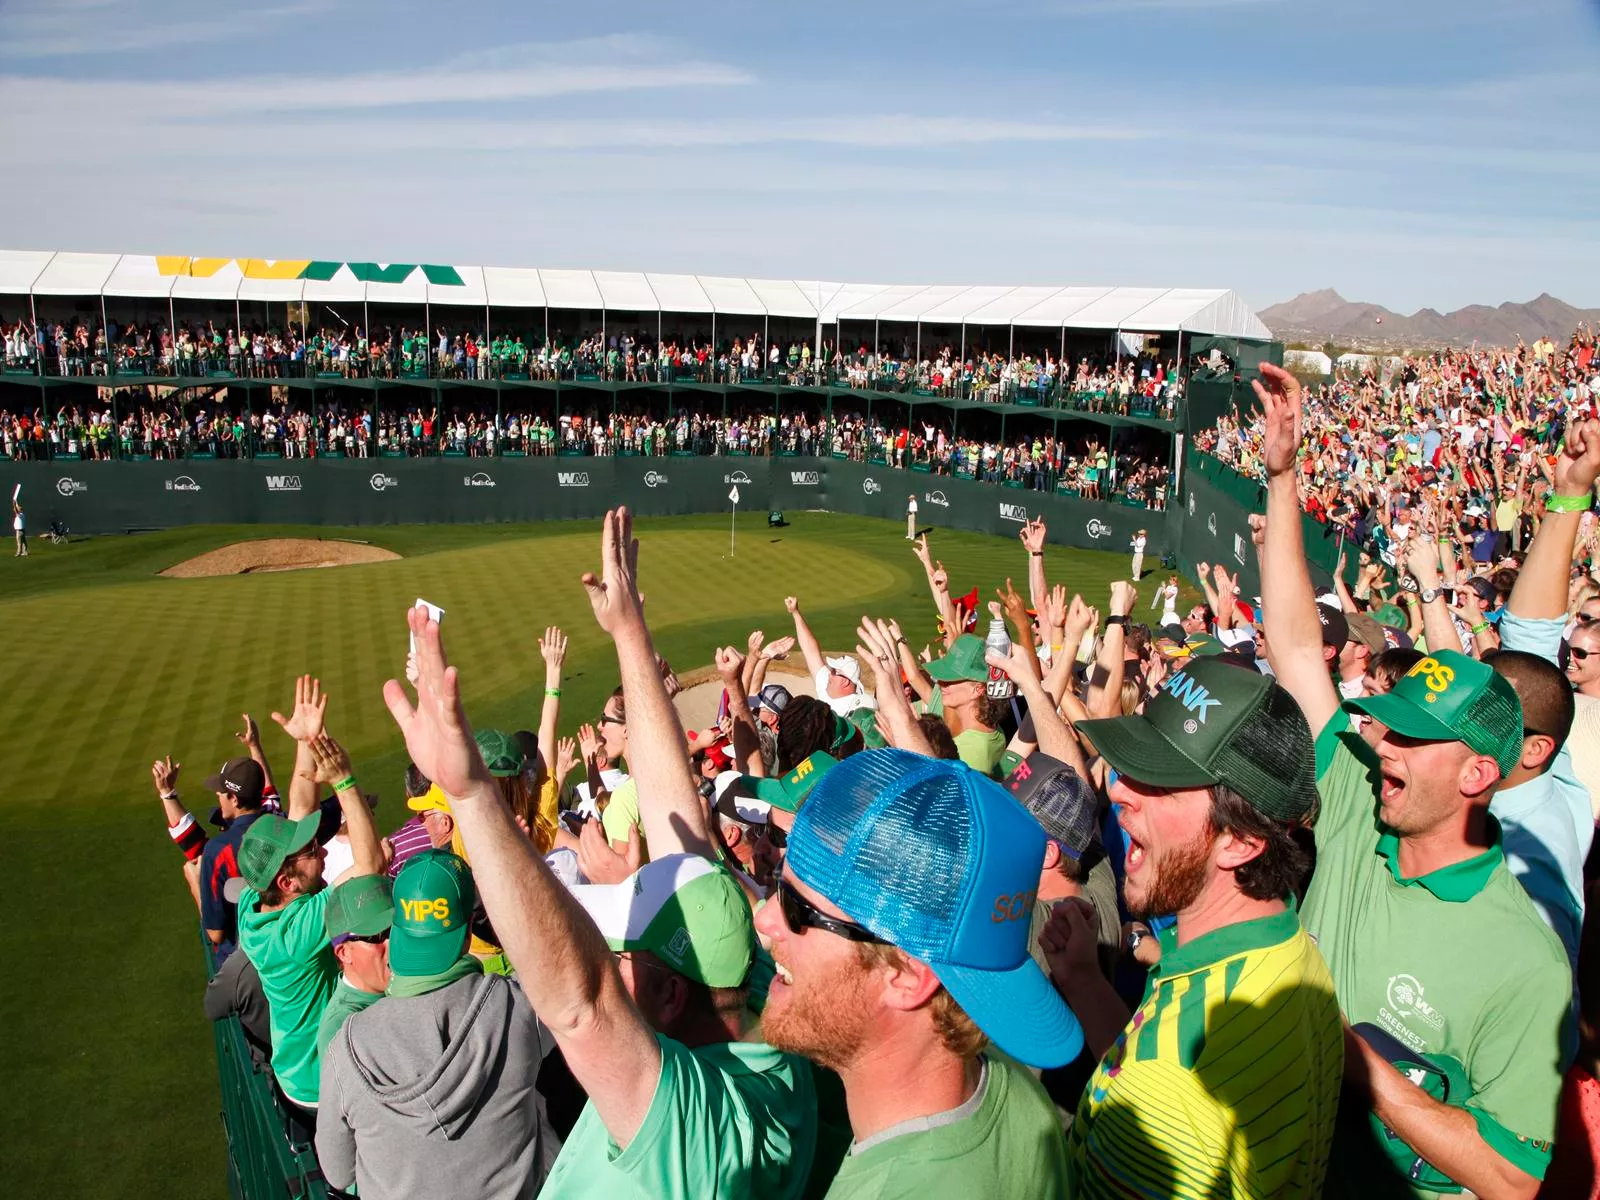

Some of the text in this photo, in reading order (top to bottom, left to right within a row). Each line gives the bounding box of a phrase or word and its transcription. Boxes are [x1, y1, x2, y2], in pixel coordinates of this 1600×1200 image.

[265, 475, 302, 488] WM
[557, 472, 590, 484] WM
[791, 471, 819, 482] WM
[999, 503, 1027, 520] WM
[400, 897, 450, 922] YIPS
[1379, 1007, 1427, 1048] GREENEST
